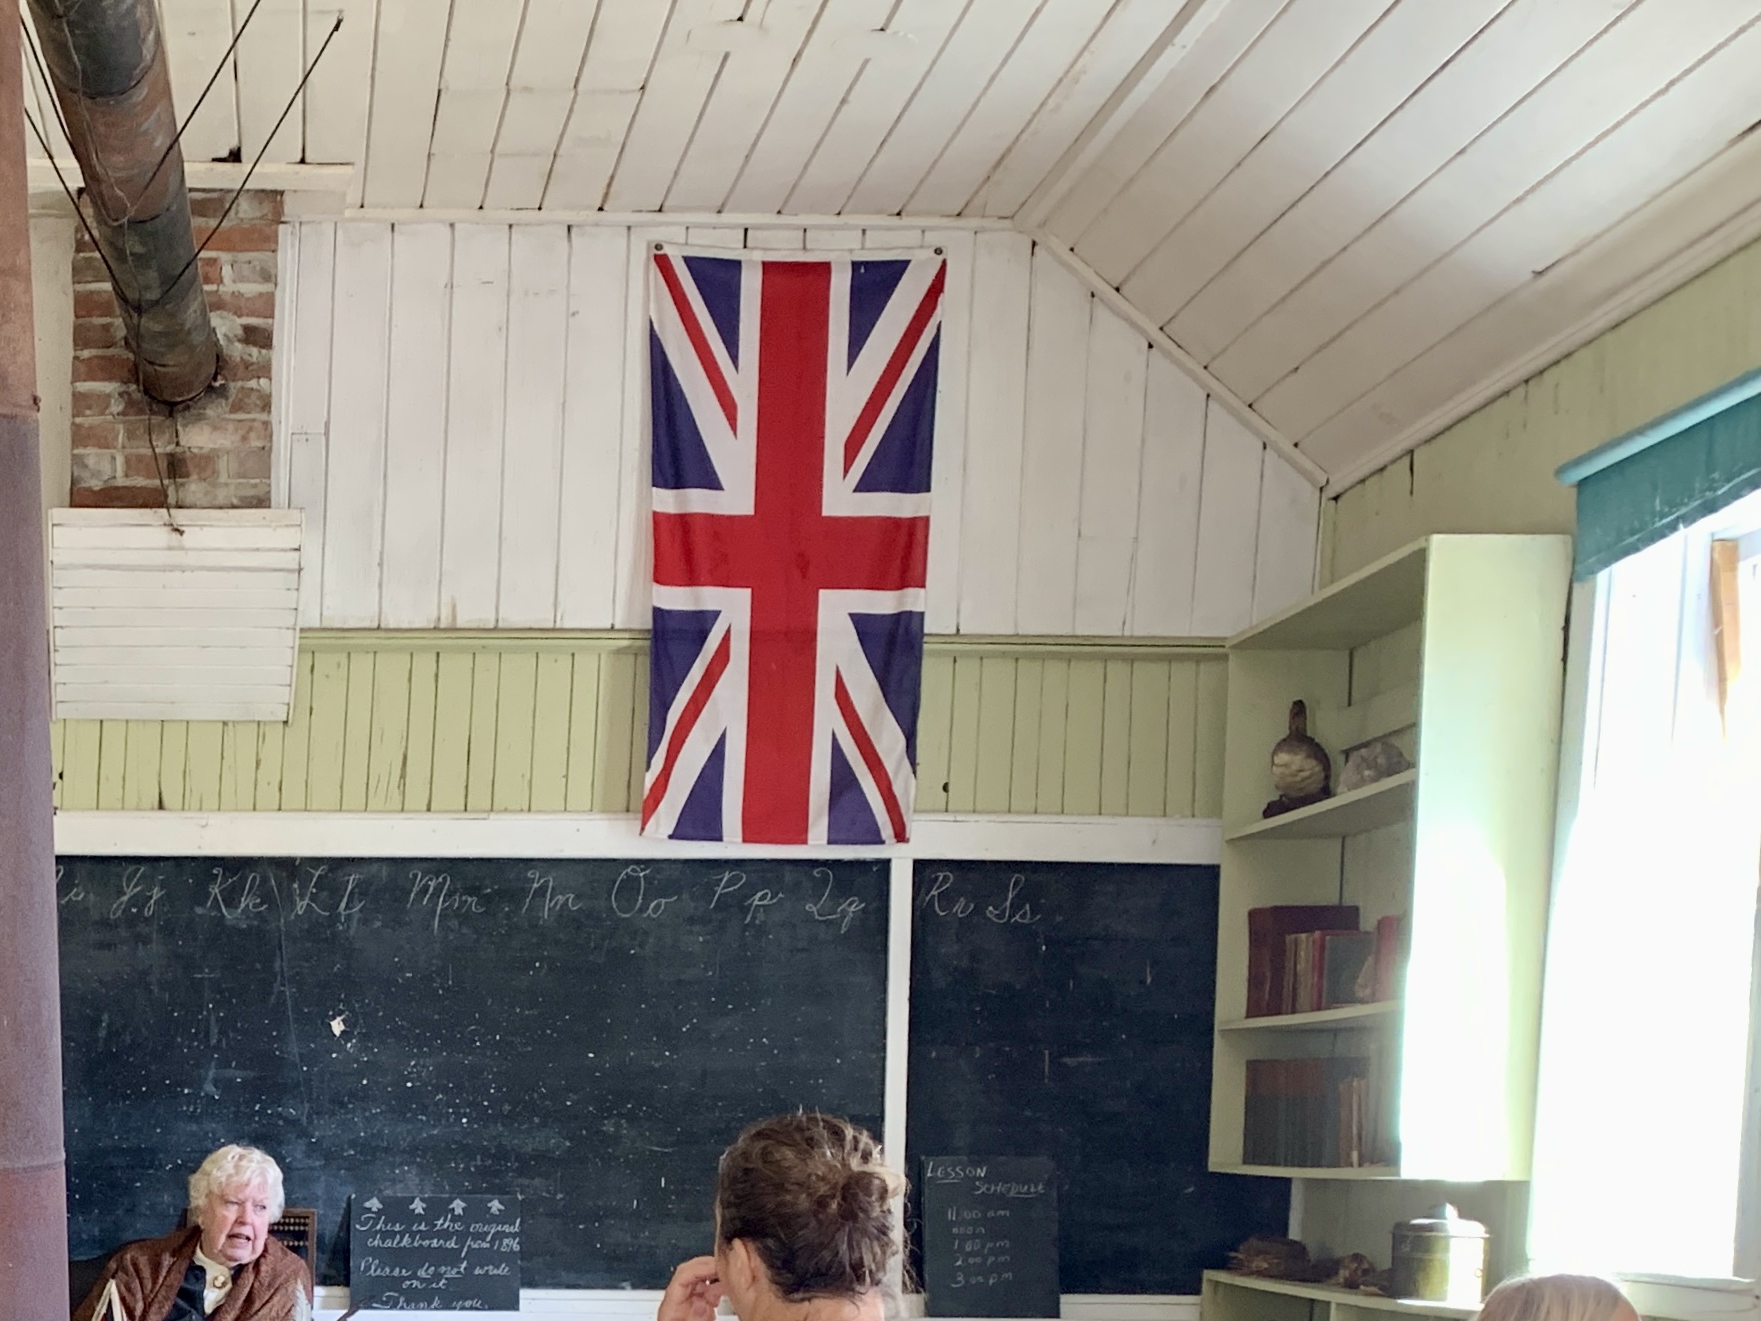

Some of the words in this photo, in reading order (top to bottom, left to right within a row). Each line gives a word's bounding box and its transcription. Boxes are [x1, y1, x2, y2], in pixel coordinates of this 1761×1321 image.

[926, 1161, 987, 1179] LESSON
[355, 1213, 406, 1232] This
[412, 1221, 429, 1232] is
[433, 1213, 465, 1232] the
[469, 1217, 521, 1242] original
[367, 1234, 460, 1249] chalkboard
[461, 1236, 491, 1258] from
[493, 1237, 521, 1252] 1896
[360, 1256, 413, 1277] Please
[417, 1262, 435, 1277] do
[438, 1259, 468, 1276] not
[473, 1261, 511, 1276] write
[402, 1279, 427, 1289] on
[372, 1292, 442, 1310] Thank
